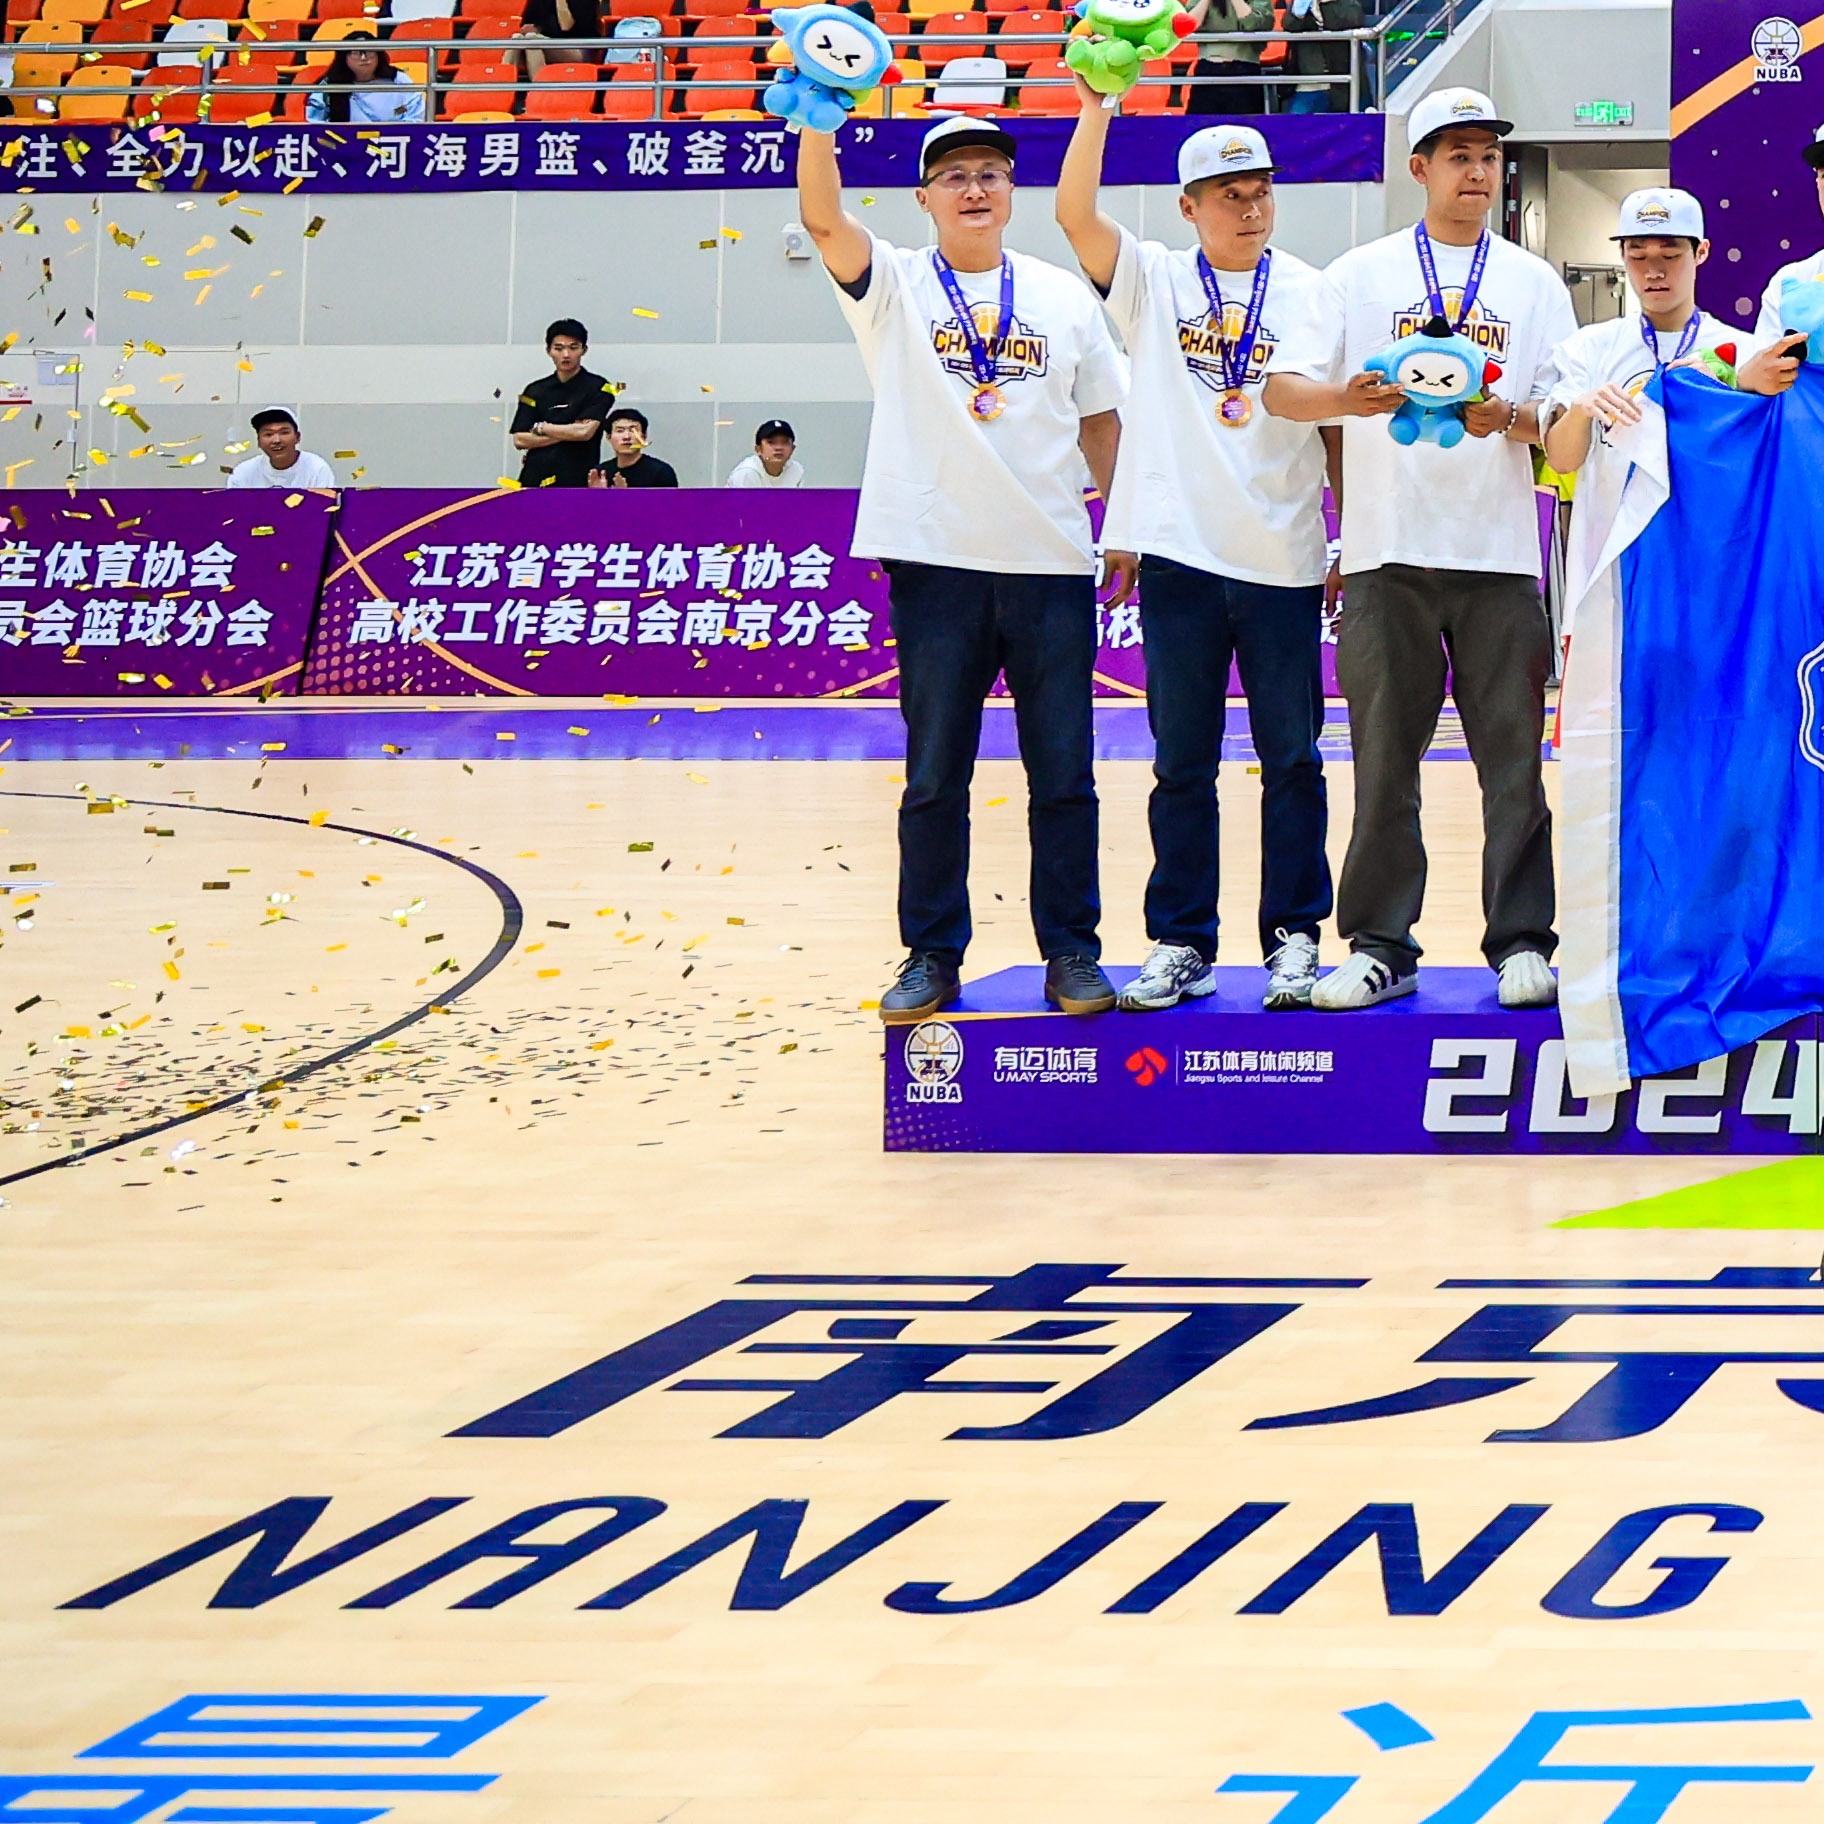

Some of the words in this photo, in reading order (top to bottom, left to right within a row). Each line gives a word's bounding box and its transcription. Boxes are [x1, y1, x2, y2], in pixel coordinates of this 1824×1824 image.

[1756, 67, 1799, 80] NUBA
[407, 541, 836, 591] 江苏省学生体育协会
[348, 598, 875, 648] 高校工作委员会南京分会
[994, 1046, 1098, 1071] 有迈体育
[1184, 1049, 1334, 1072] 江苏体育休闲频道
[1040, 1072, 1098, 1084] SPORTS
[1290, 1074, 1324, 1083] Channel
[908, 1084, 961, 1102] NUBA
[60, 1494, 1766, 1620] NANJING
